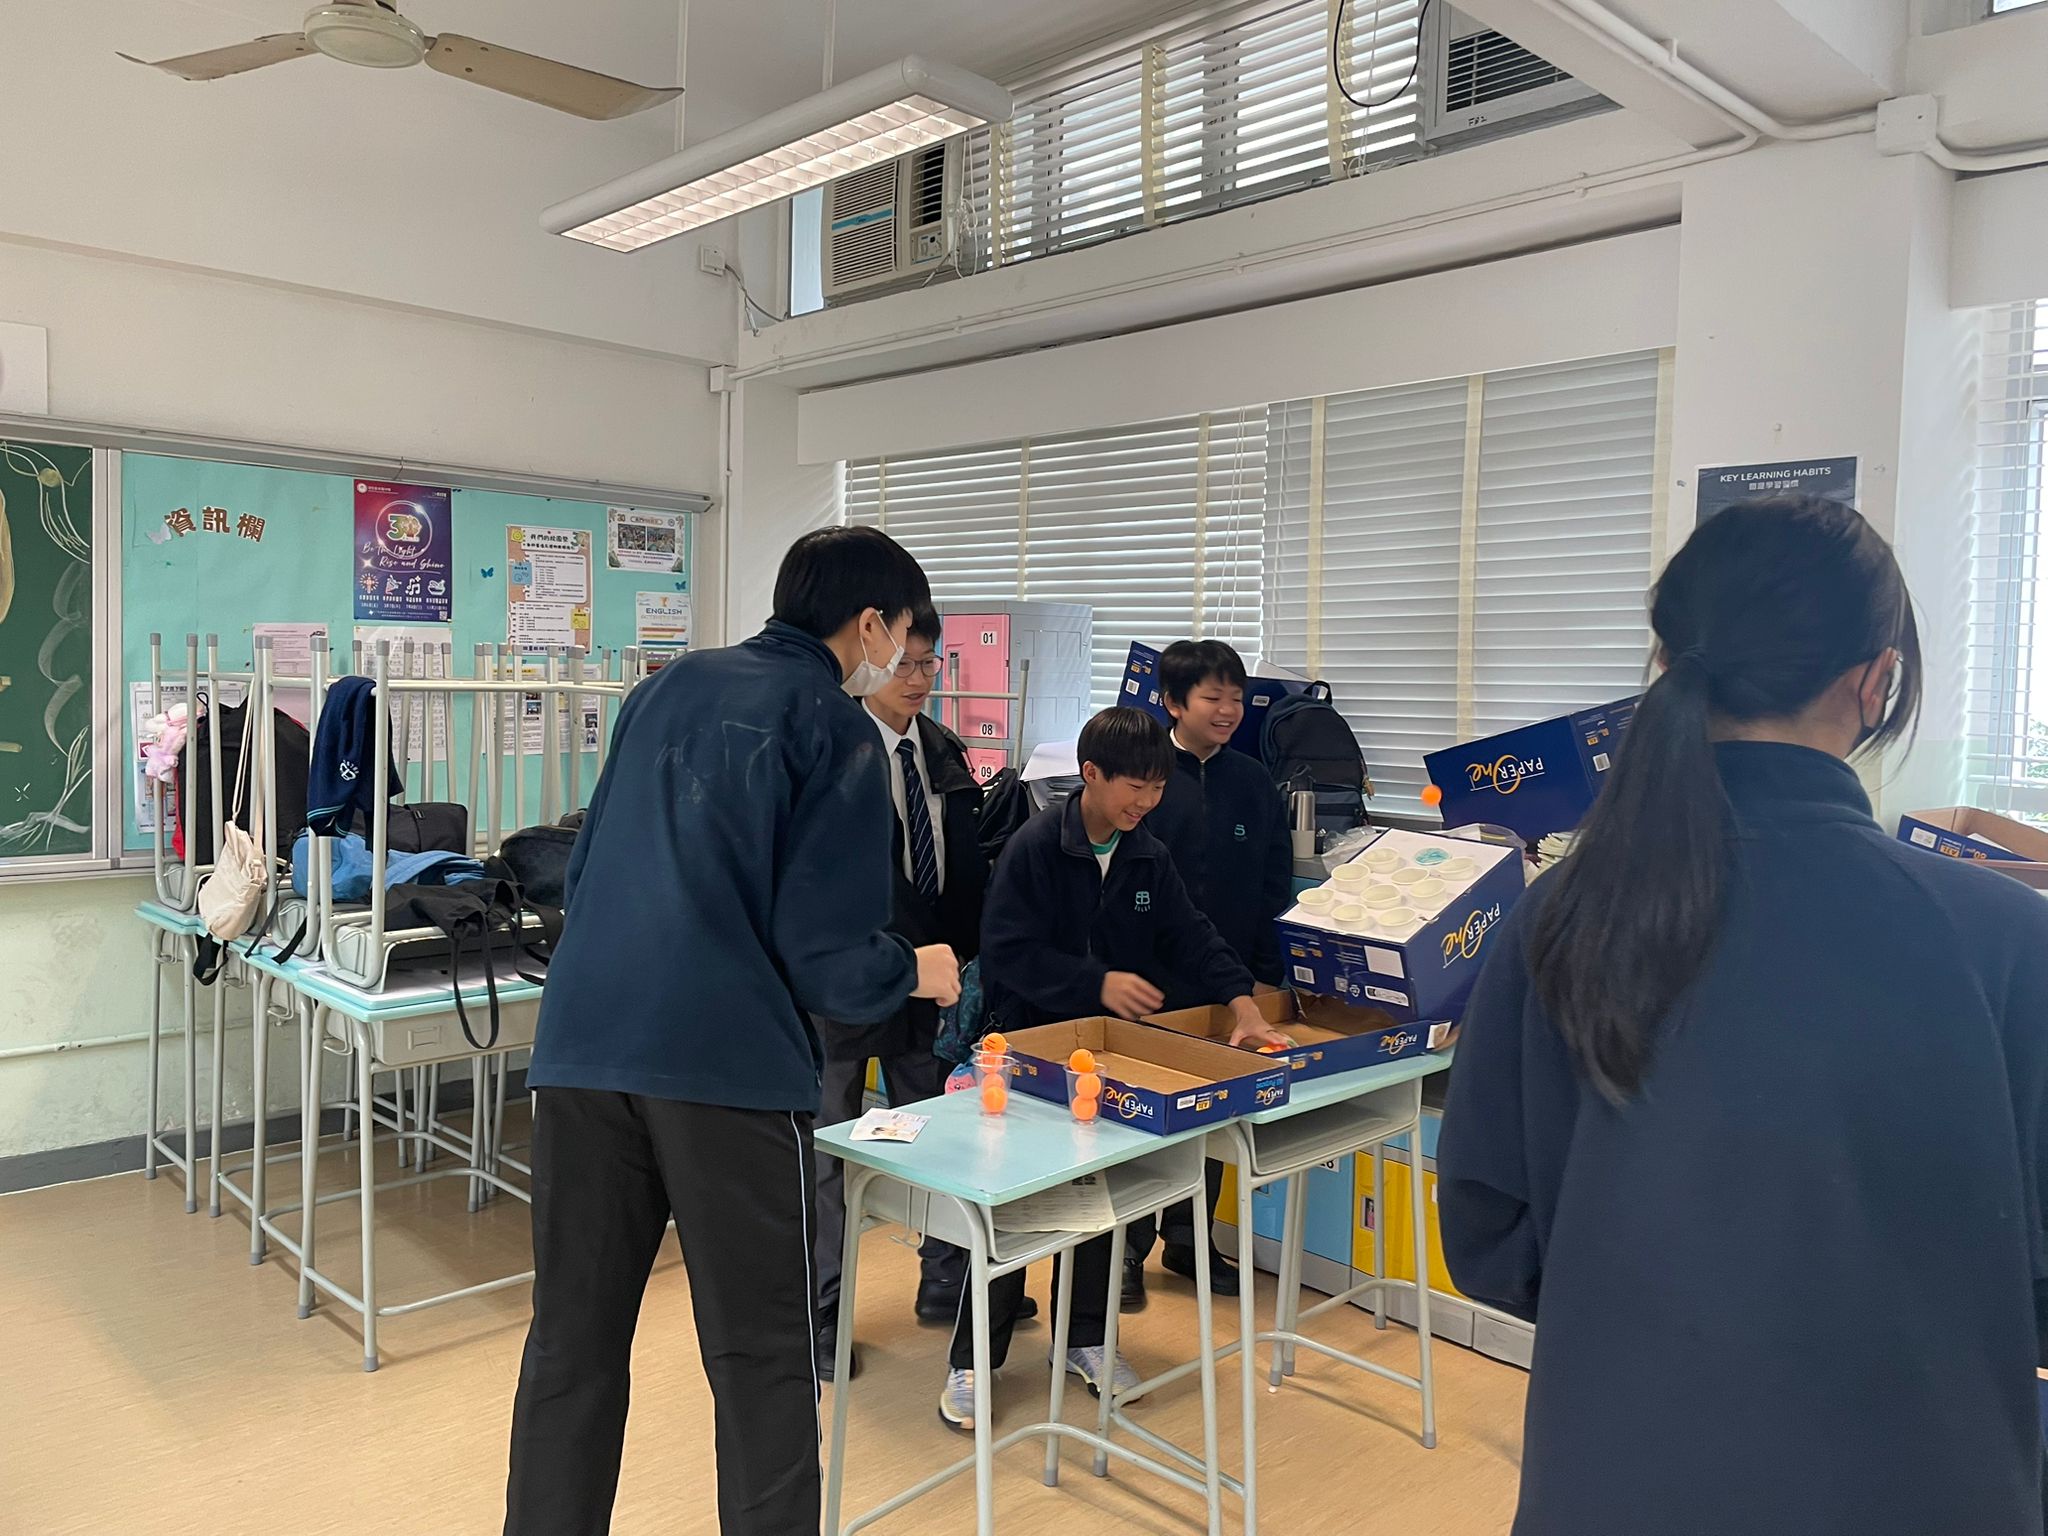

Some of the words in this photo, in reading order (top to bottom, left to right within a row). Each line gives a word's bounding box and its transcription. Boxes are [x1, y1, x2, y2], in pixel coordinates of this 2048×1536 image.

[1720, 473, 1739, 483] KEY
[1741, 469, 1791, 482] LEARNING
[1793, 466, 1832, 478] HABITS
[164, 506, 266, 543] 資訊欄
[379, 556, 398, 568] Rise
[401, 559, 417, 569] and
[645, 607, 683, 615] ENGLISH
[982, 632, 994, 644] 01
[981, 724, 993, 736] 08
[980, 766, 992, 778] 09
[1499, 757, 1545, 780] PAPER
[1466, 902, 1500, 940] PAPER
[1124, 1099, 1153, 1116] PAPER
